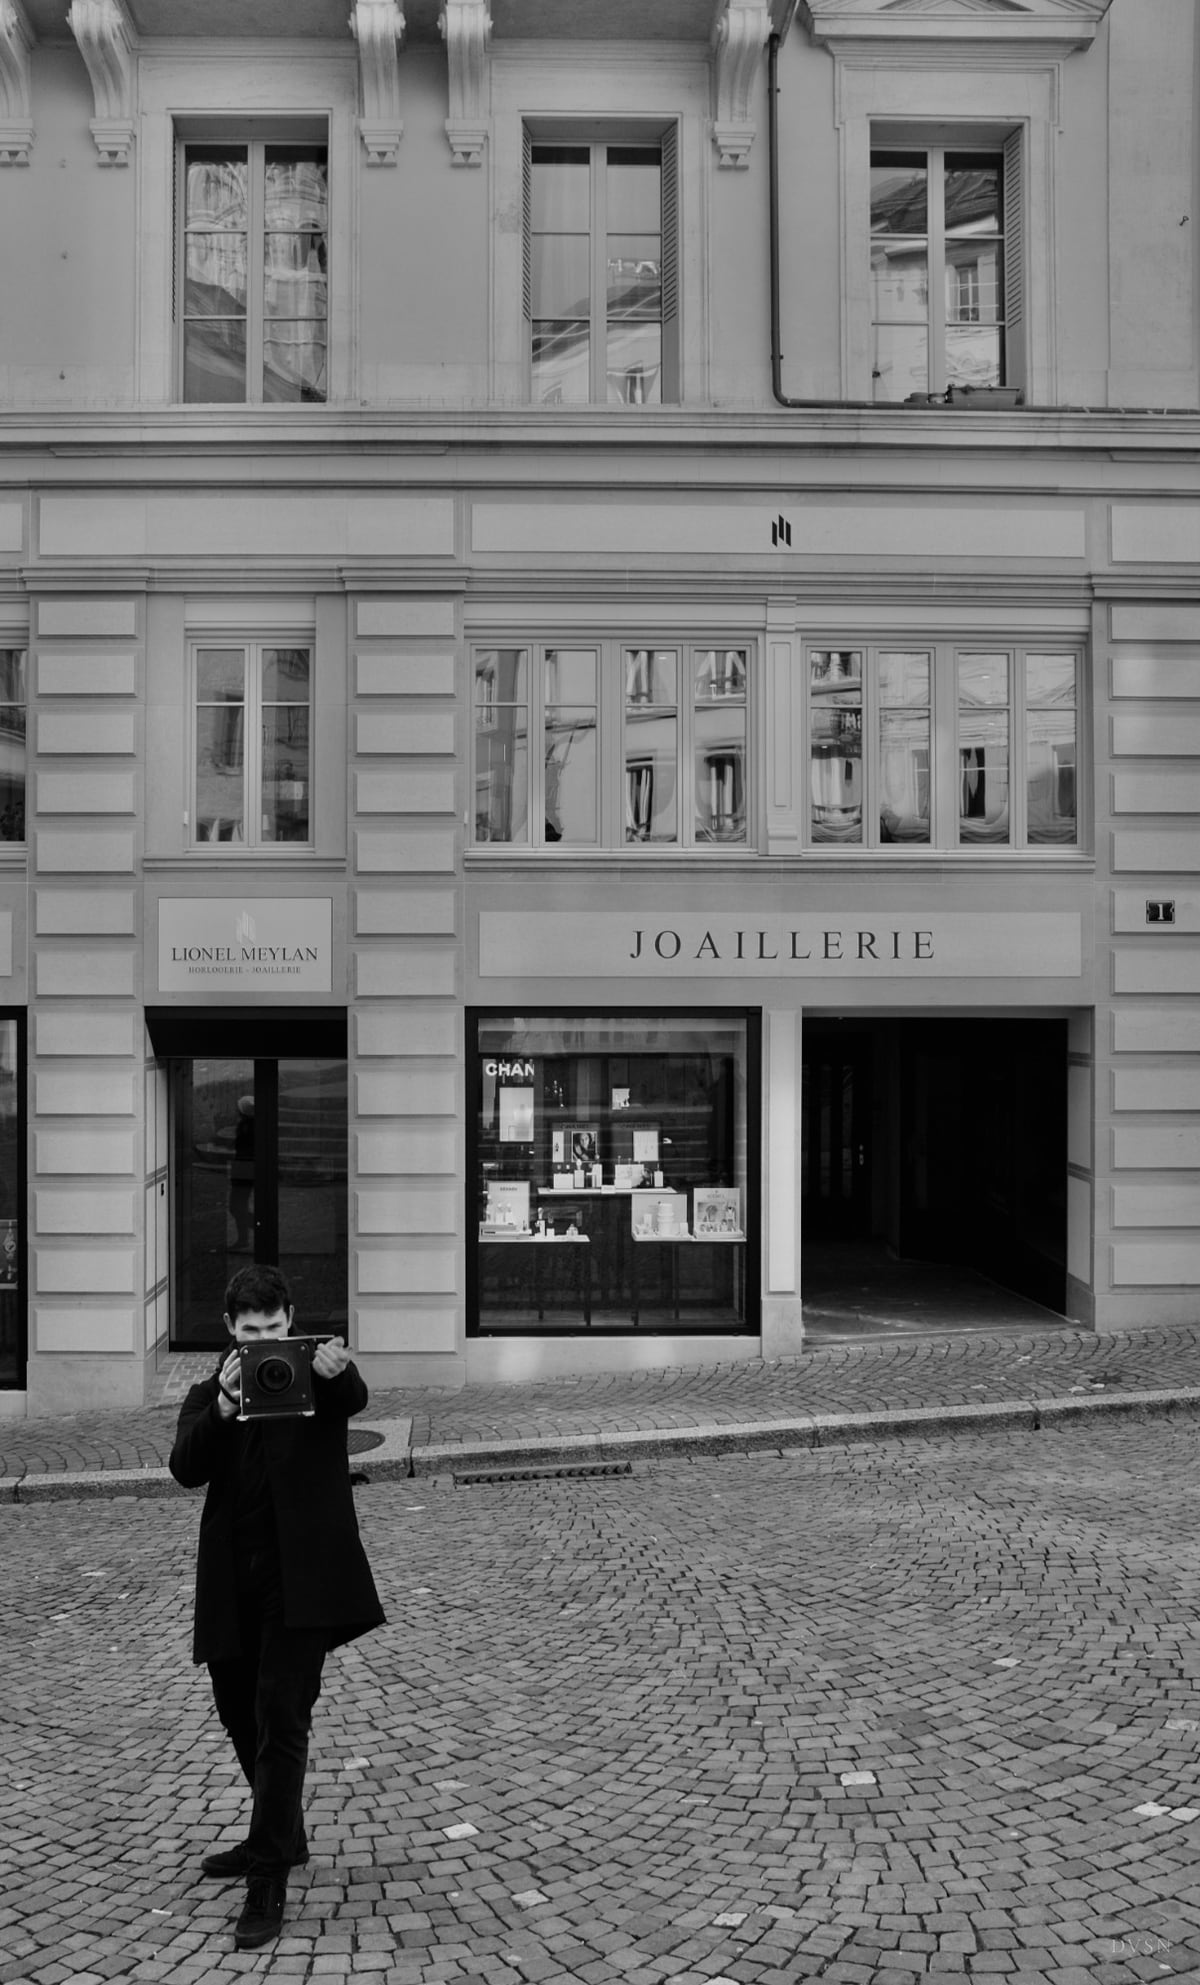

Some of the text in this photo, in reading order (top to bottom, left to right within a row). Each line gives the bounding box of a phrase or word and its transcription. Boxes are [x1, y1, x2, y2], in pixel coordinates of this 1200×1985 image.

[1157, 903, 1165, 920] 1
[629, 930, 935, 960] JOAILLERIE
[171, 947, 318, 962] LIONEL MEYLAN
[251, 966, 301, 975] JOAILLERIE
[485, 1062, 535, 1077] CHAN
